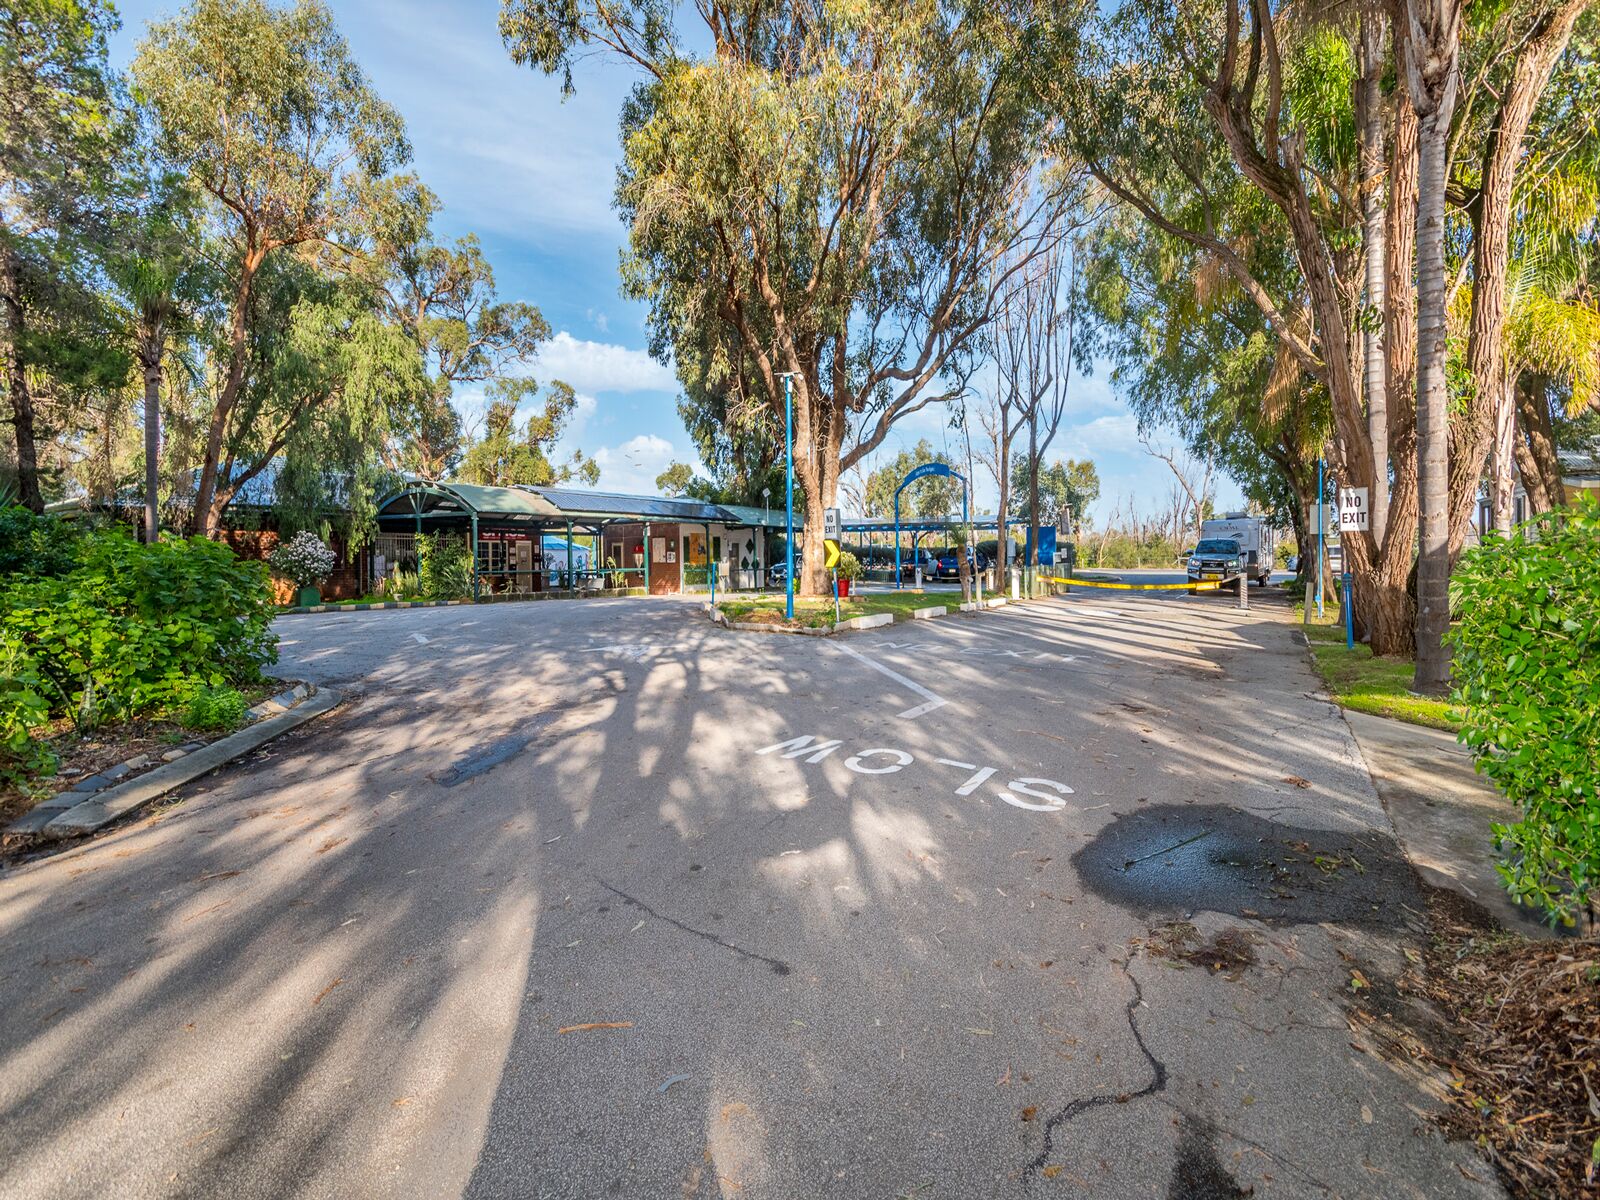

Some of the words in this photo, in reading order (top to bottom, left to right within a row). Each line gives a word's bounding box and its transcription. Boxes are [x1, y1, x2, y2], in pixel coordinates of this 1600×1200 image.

[1346, 496, 1361, 508] NO
[826, 515, 834, 523] NO
[1342, 512, 1367, 523] EXIT
[825, 525, 836, 533] EXIT
[874, 642, 943, 650] NO
[959, 647, 1092, 662] EXIT
[755, 735, 1075, 812] SLOW
